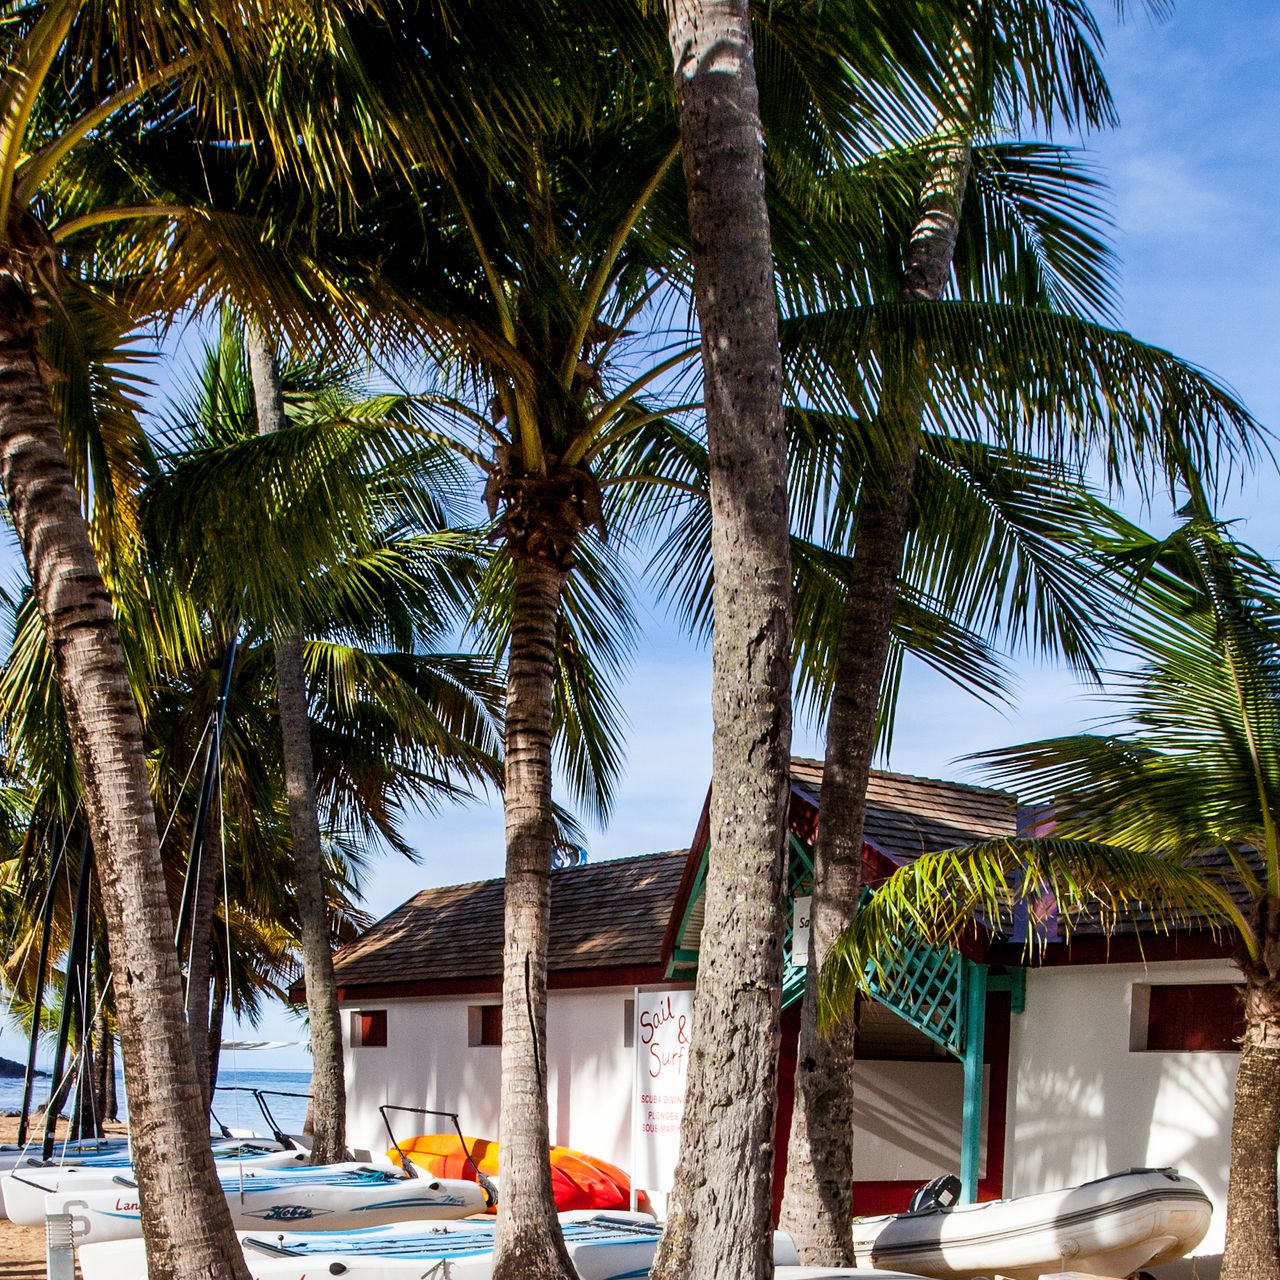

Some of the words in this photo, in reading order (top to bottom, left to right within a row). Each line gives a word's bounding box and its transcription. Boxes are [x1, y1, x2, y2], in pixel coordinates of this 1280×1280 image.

[640, 996, 675, 1044] Sail
[677, 1014, 689, 1045] &
[649, 1042, 686, 1078] Surf
